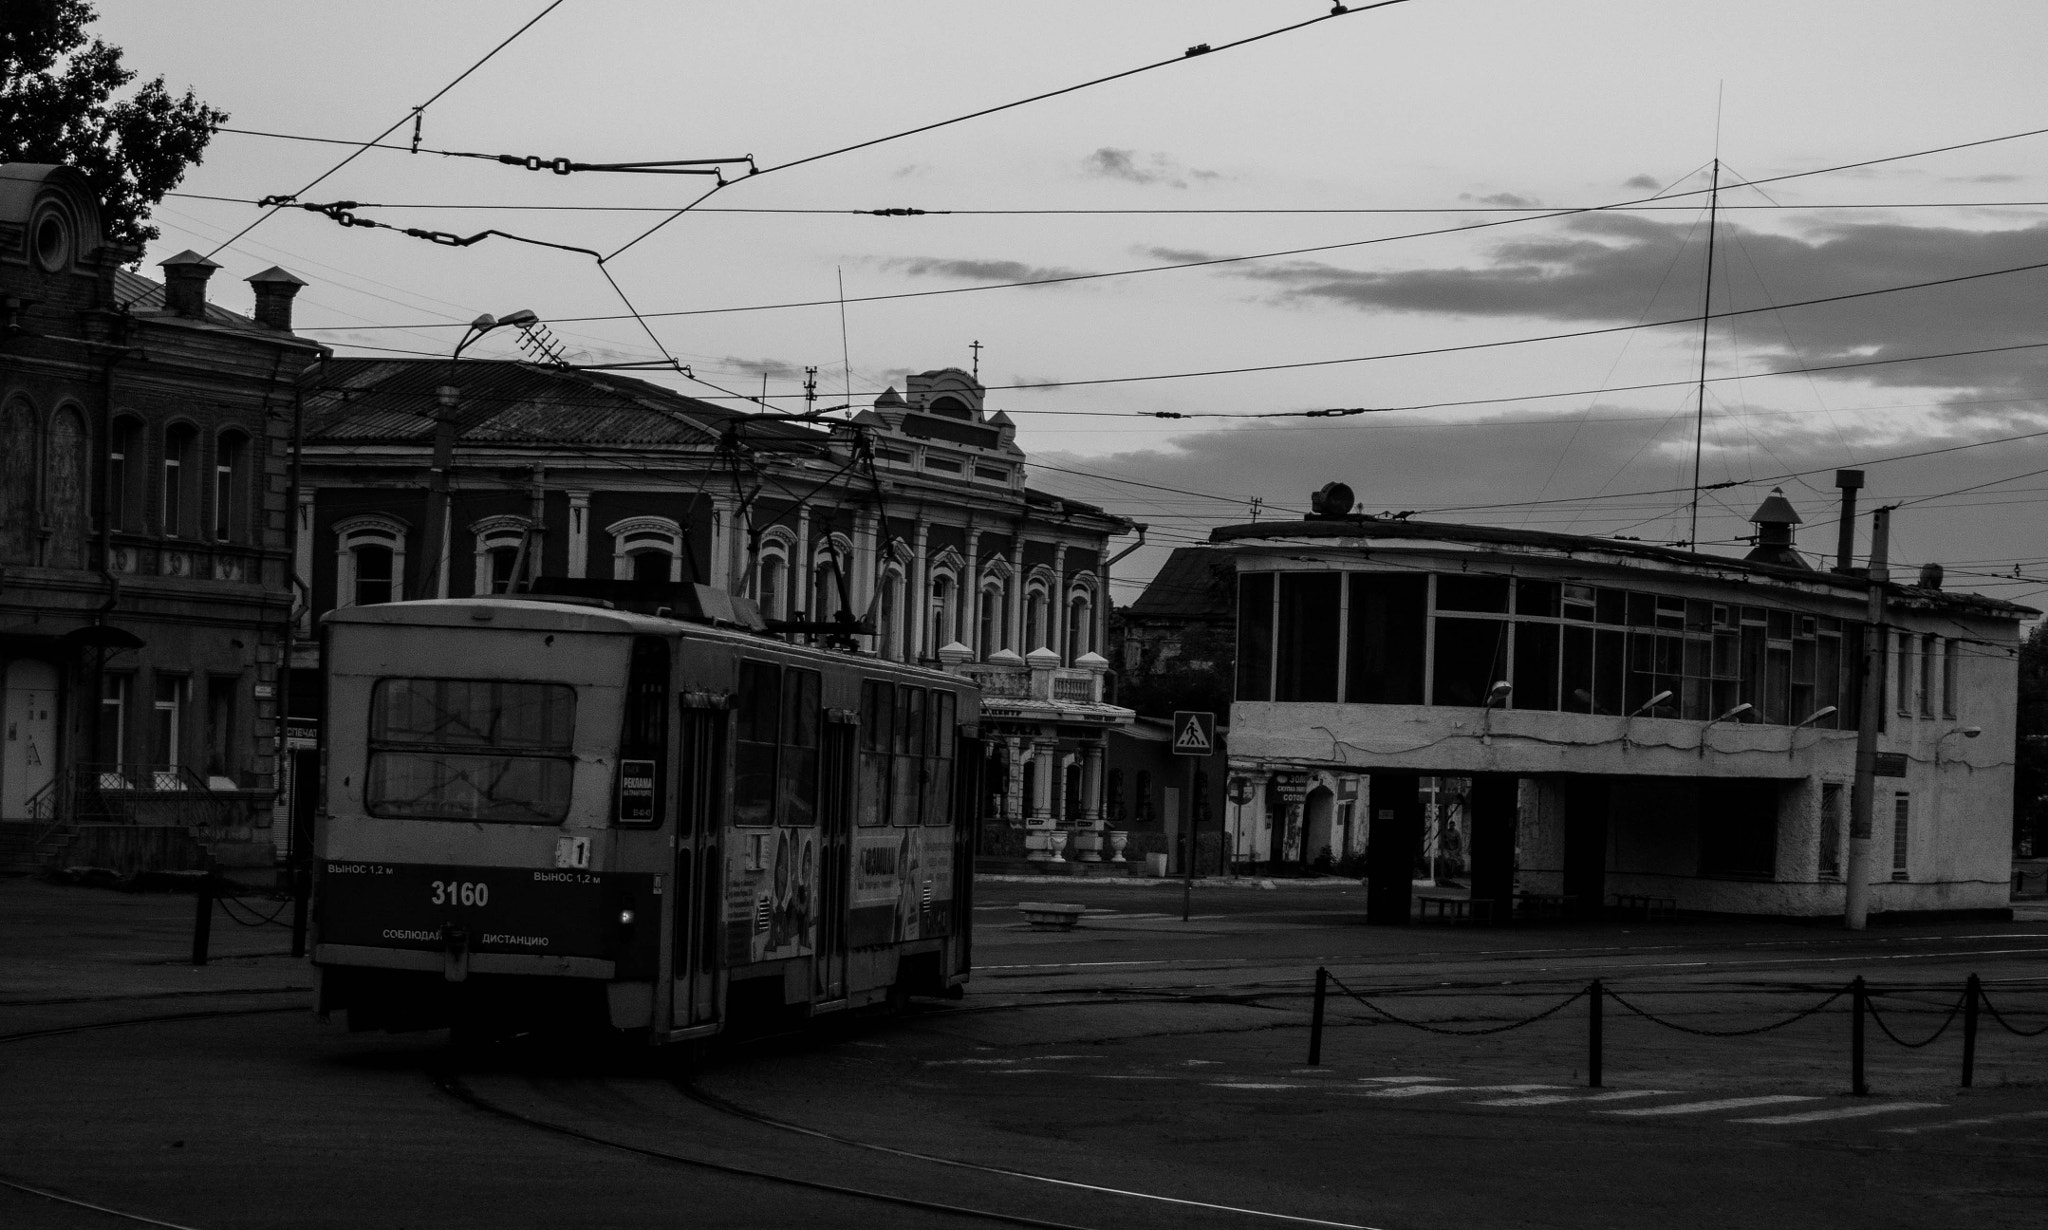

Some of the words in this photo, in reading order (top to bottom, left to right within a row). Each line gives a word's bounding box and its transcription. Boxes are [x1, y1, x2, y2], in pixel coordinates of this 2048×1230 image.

[275, 726, 318, 738] РСПЕЧАТ
[623, 776, 652, 789] РЕКЛАМА
[577, 842, 585, 865] 1
[327, 864, 367, 874] ВЫНОС
[369, 865, 384, 875] 1,2
[533, 871, 573, 882] ВЫНОС
[576, 874, 591, 884] 1,2
[431, 880, 489, 907] 3160
[481, 933, 549, 948] ДИСТАНЦИЮ
